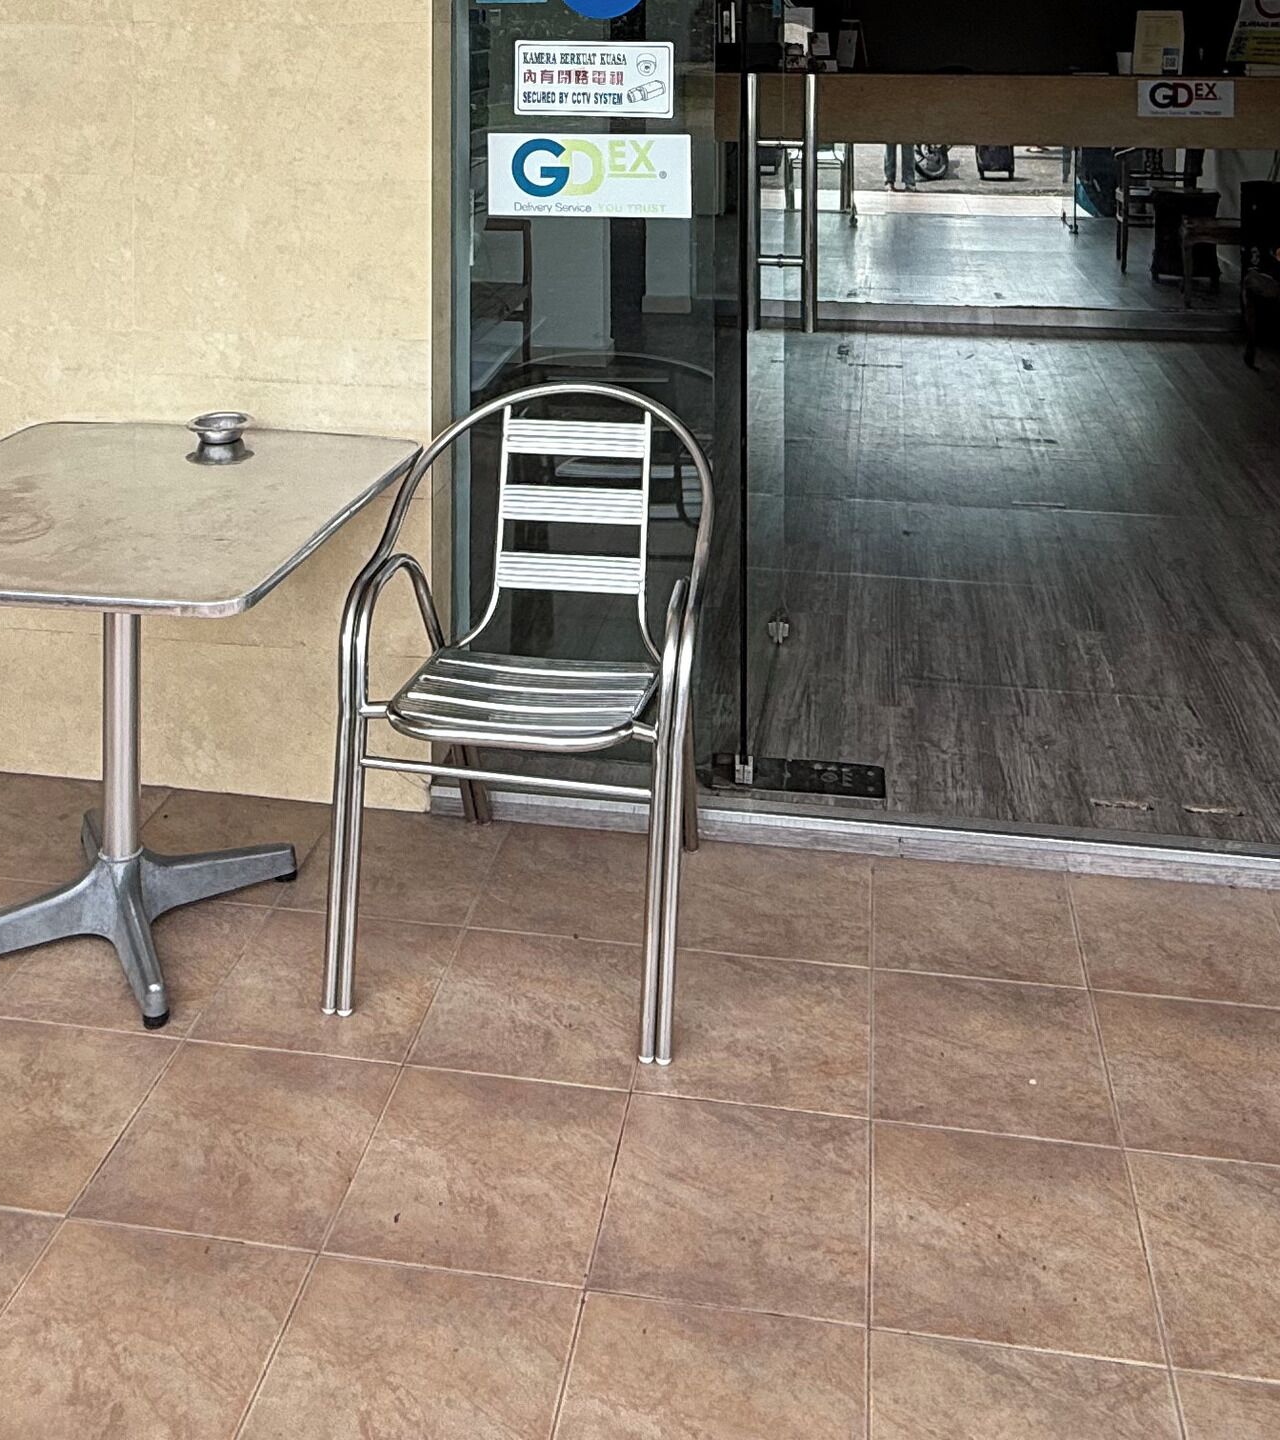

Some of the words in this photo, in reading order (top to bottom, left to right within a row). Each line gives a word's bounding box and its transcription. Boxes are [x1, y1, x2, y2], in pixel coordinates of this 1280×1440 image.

[523, 52, 557, 64] KAMERA
[600, 53, 627, 65] KUASA
[522, 91, 556, 104] SECURED
[558, 91, 569, 104] BY
[571, 92, 591, 104] CCTV
[593, 92, 623, 105] SYSTEM
[1149, 82, 1218, 109] GDEX
[511, 138, 658, 198] GDEX
[513, 202, 553, 213] Delivery
[555, 202, 592, 213] Service
[627, 203, 667, 213] TRUST
